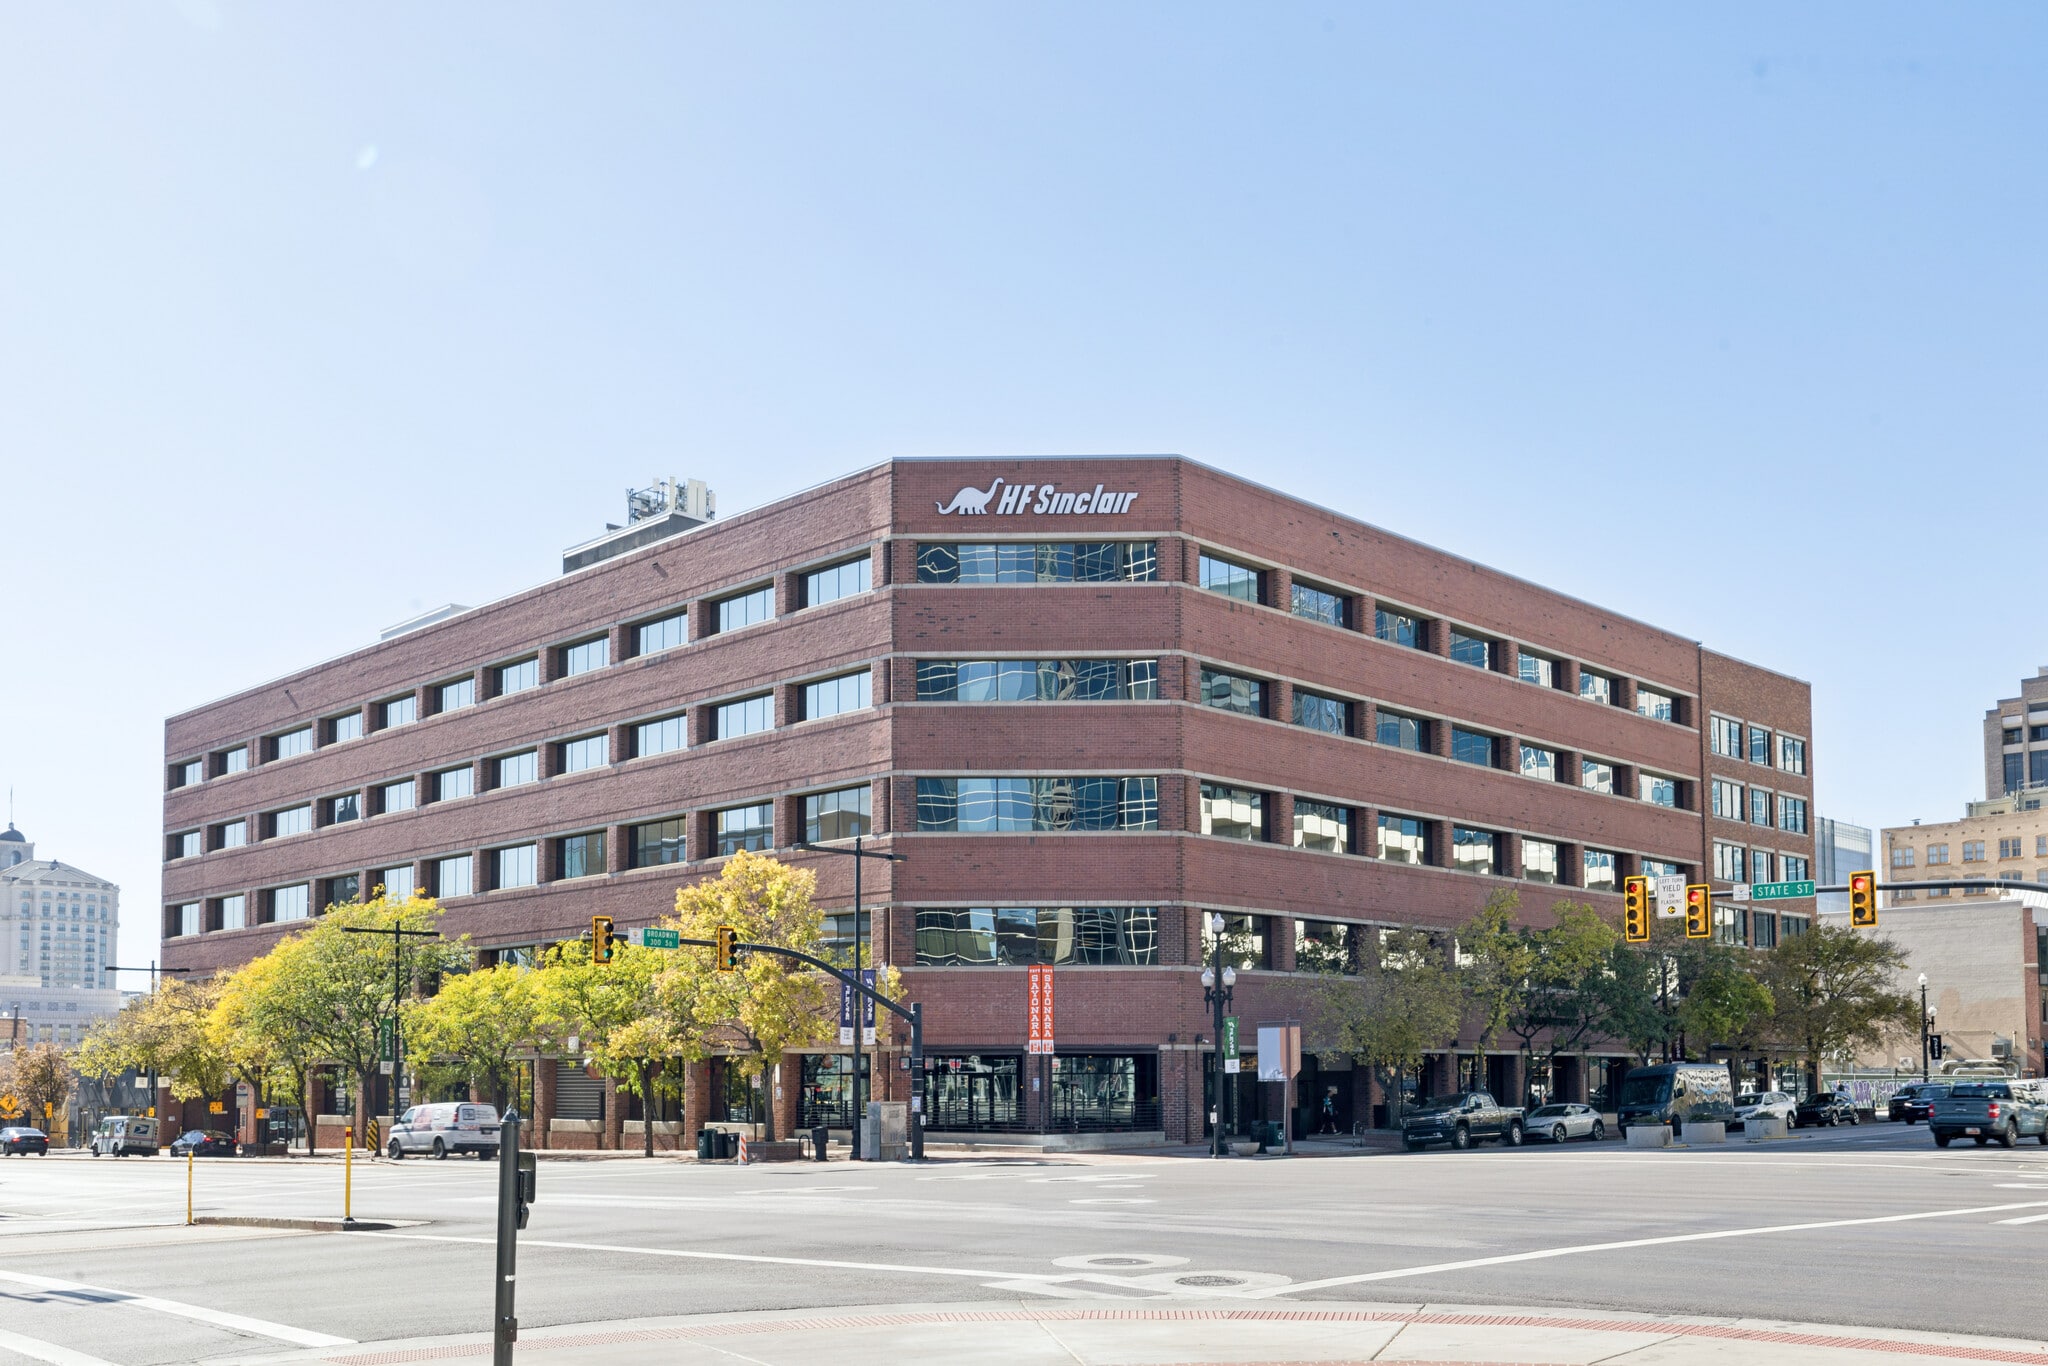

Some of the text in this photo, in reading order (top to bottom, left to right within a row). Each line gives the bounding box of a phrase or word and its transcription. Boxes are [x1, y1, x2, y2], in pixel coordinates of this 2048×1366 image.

[995, 483, 1139, 515] HF Sinclair
[1662, 882, 1681, 892] YIELD
[1757, 885, 1789, 897] STATE
[1797, 883, 1812, 894] ST.
[1660, 898, 1683, 906] FLASHING
[646, 930, 678, 940] BROADWAY
[1031, 974, 1039, 1038] SAYONARA
[1043, 974, 1052, 1038] SAYONARA
